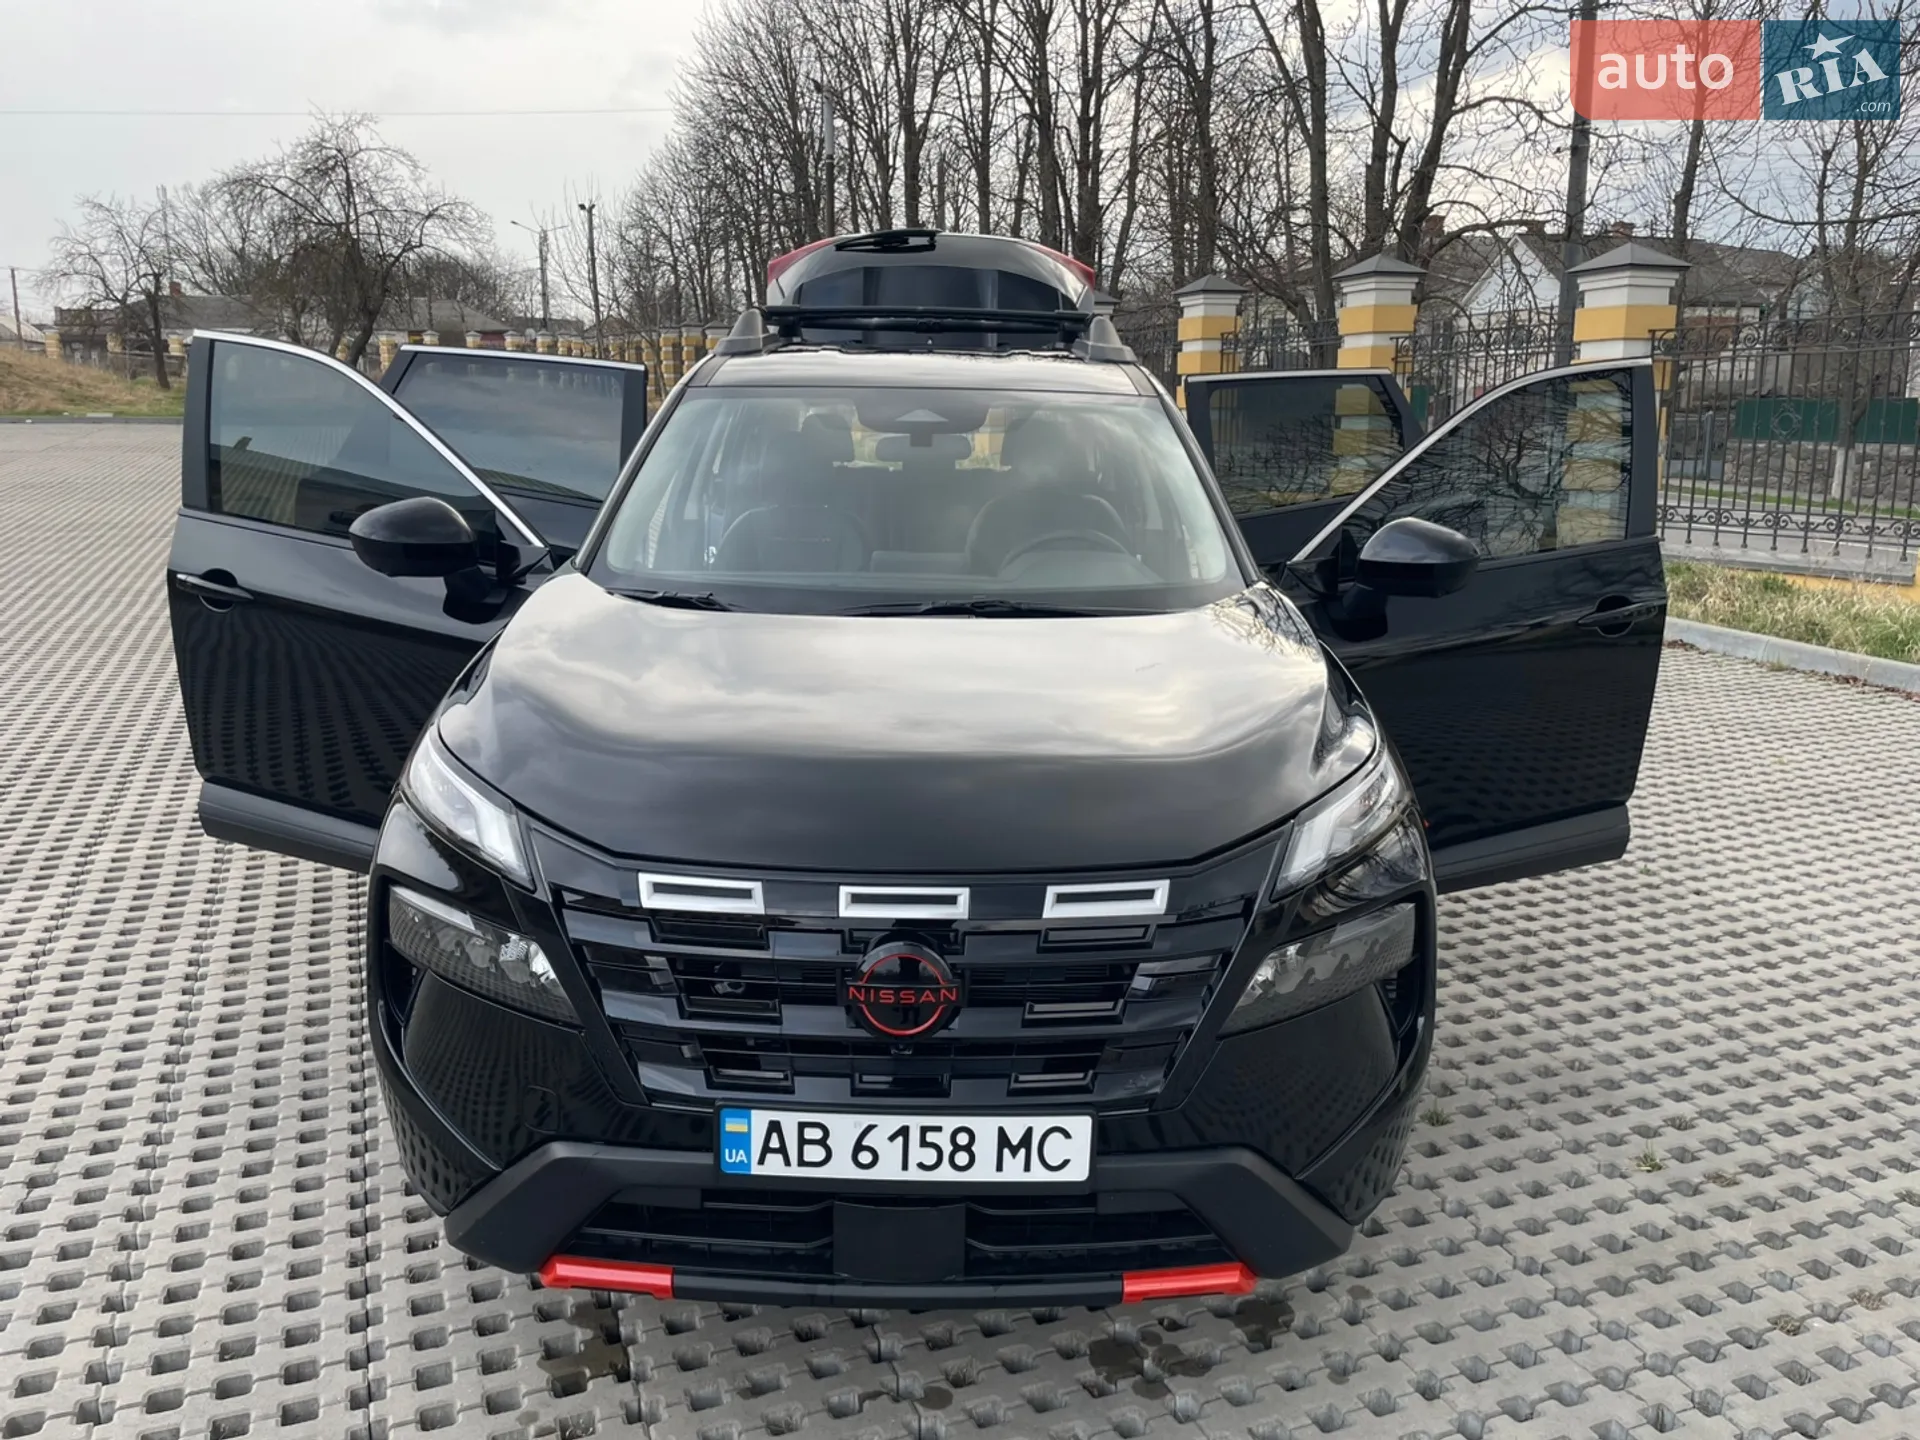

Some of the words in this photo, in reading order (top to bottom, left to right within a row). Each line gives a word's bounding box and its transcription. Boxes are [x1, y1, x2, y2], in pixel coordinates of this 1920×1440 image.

[848, 986, 957, 1004] NISSAN
[757, 1119, 833, 1168] AB
[851, 1123, 976, 1172] 6158
[995, 1125, 1072, 1173] MC
[725, 1149, 748, 1164] UA
